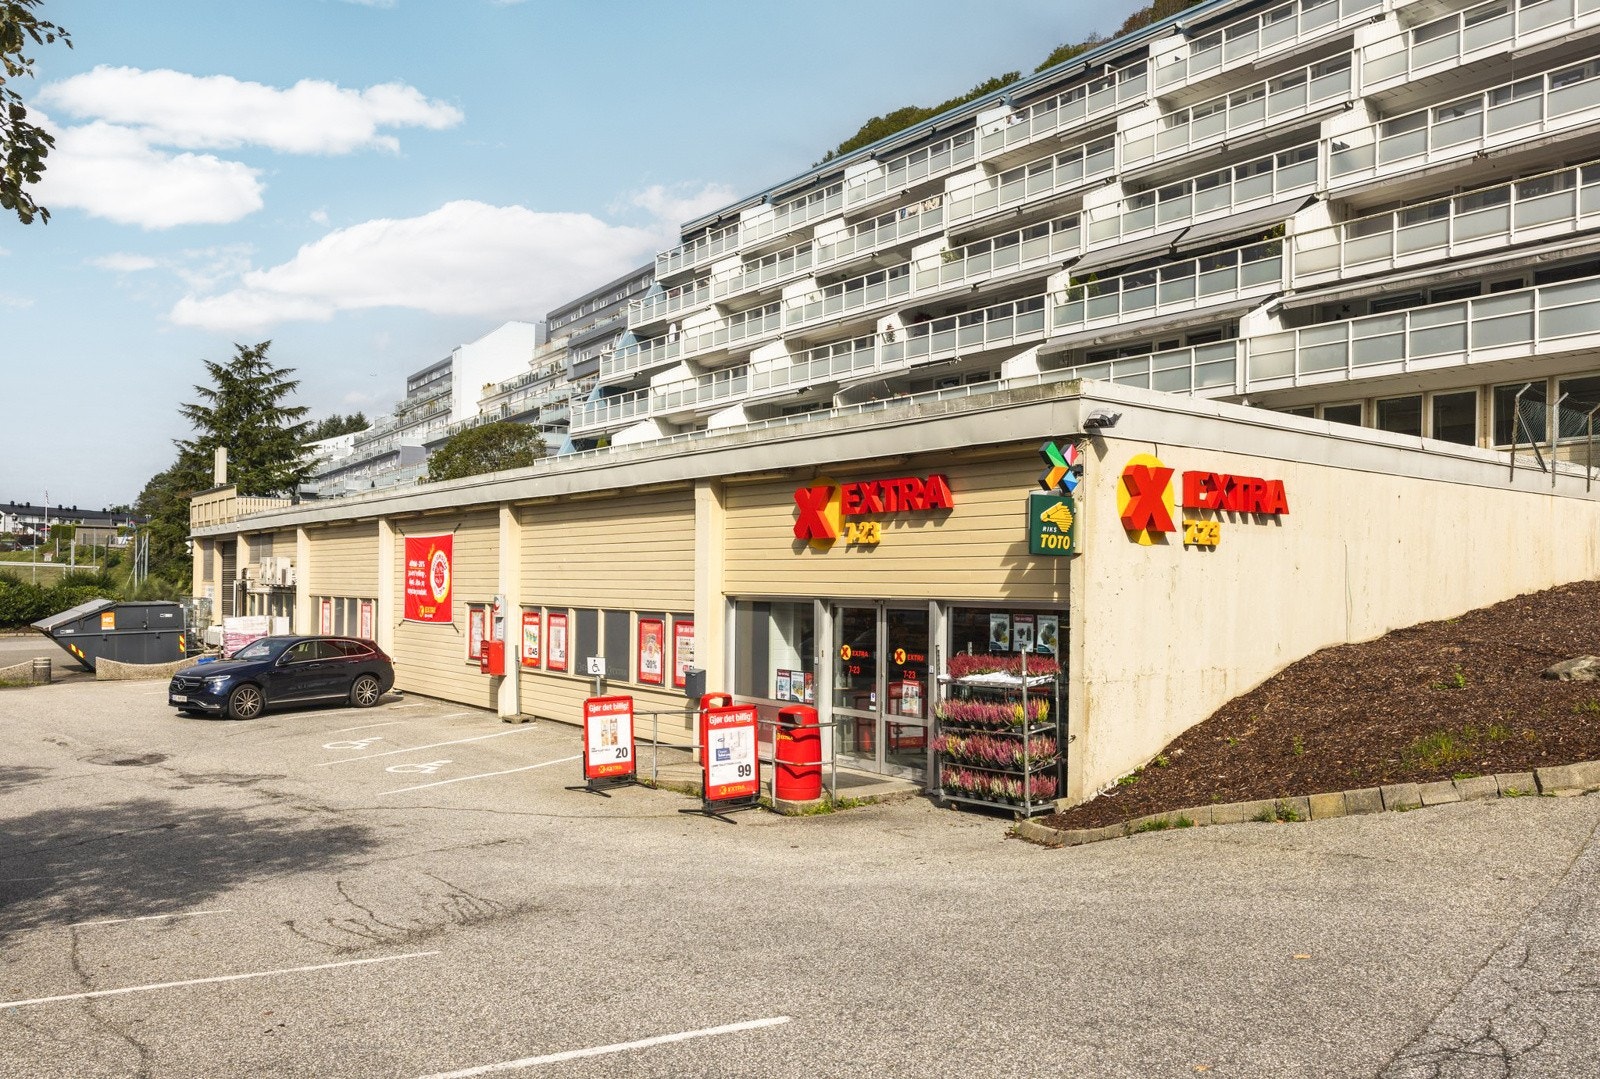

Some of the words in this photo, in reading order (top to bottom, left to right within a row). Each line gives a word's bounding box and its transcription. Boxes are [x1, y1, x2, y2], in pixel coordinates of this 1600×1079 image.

[841, 474, 955, 516] EXTRA
[1182, 470, 1290, 515] EXTRA
[845, 521, 882, 545] 7-23
[1183, 519, 1221, 546] 7-23
[1040, 533, 1071, 550] TOTO
[852, 650, 869, 658] EXTRA
[848, 665, 861, 674] 7-23
[903, 670, 916, 679] 7-23
[588, 704, 602, 713] Gjør
[602, 703, 613, 711] det
[613, 702, 629, 712] billig!
[709, 715, 723, 726] Gjør
[723, 714, 735, 723] det
[735, 712, 753, 724] billig!
[615, 747, 628, 759] 20
[737, 763, 752, 778] 99
